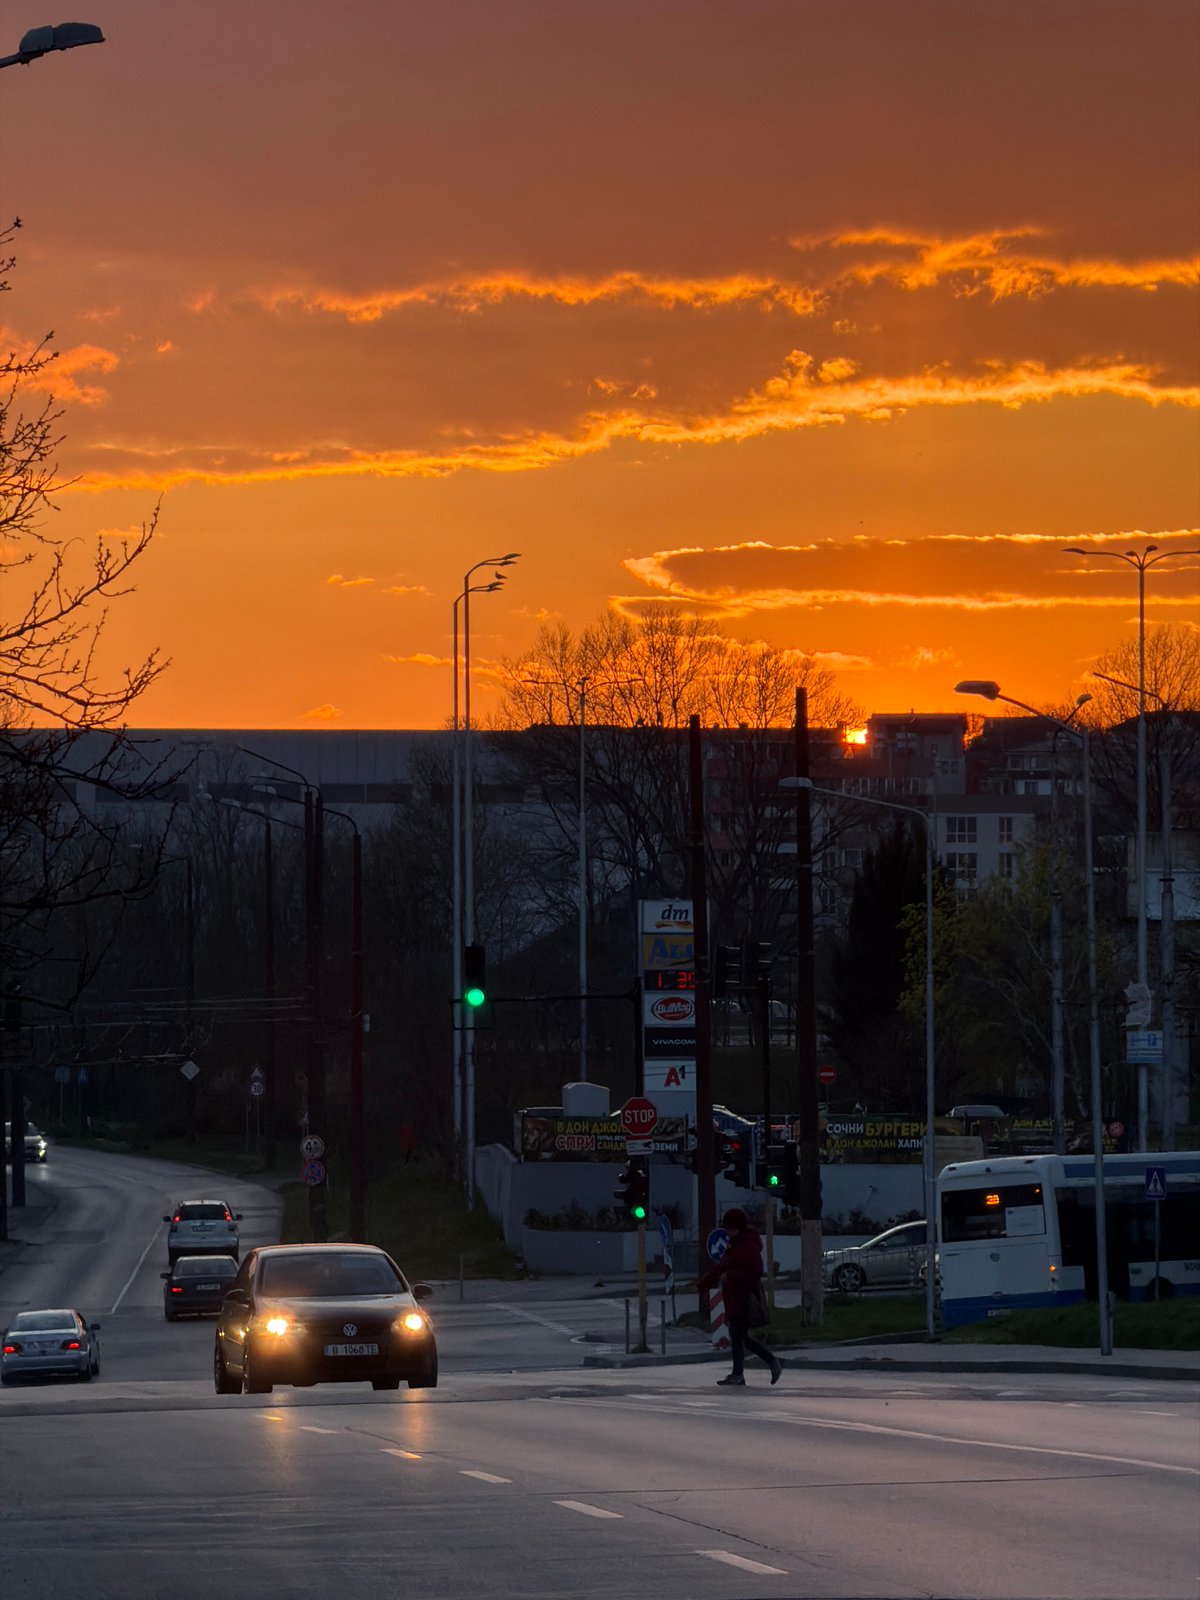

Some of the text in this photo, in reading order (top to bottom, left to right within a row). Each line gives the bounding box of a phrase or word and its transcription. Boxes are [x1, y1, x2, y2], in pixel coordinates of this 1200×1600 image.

[661, 904, 689, 921] dm
[664, 1065, 686, 1088] A1
[624, 1109, 655, 1124] STOP
[565, 1121, 589, 1134] ДОН
[826, 1122, 864, 1134] СОЧНИ
[834, 1138, 854, 1149] ДОН
[855, 1138, 896, 1149] ДЖОЛАН
[897, 1138, 923, 1149] ХАПН
